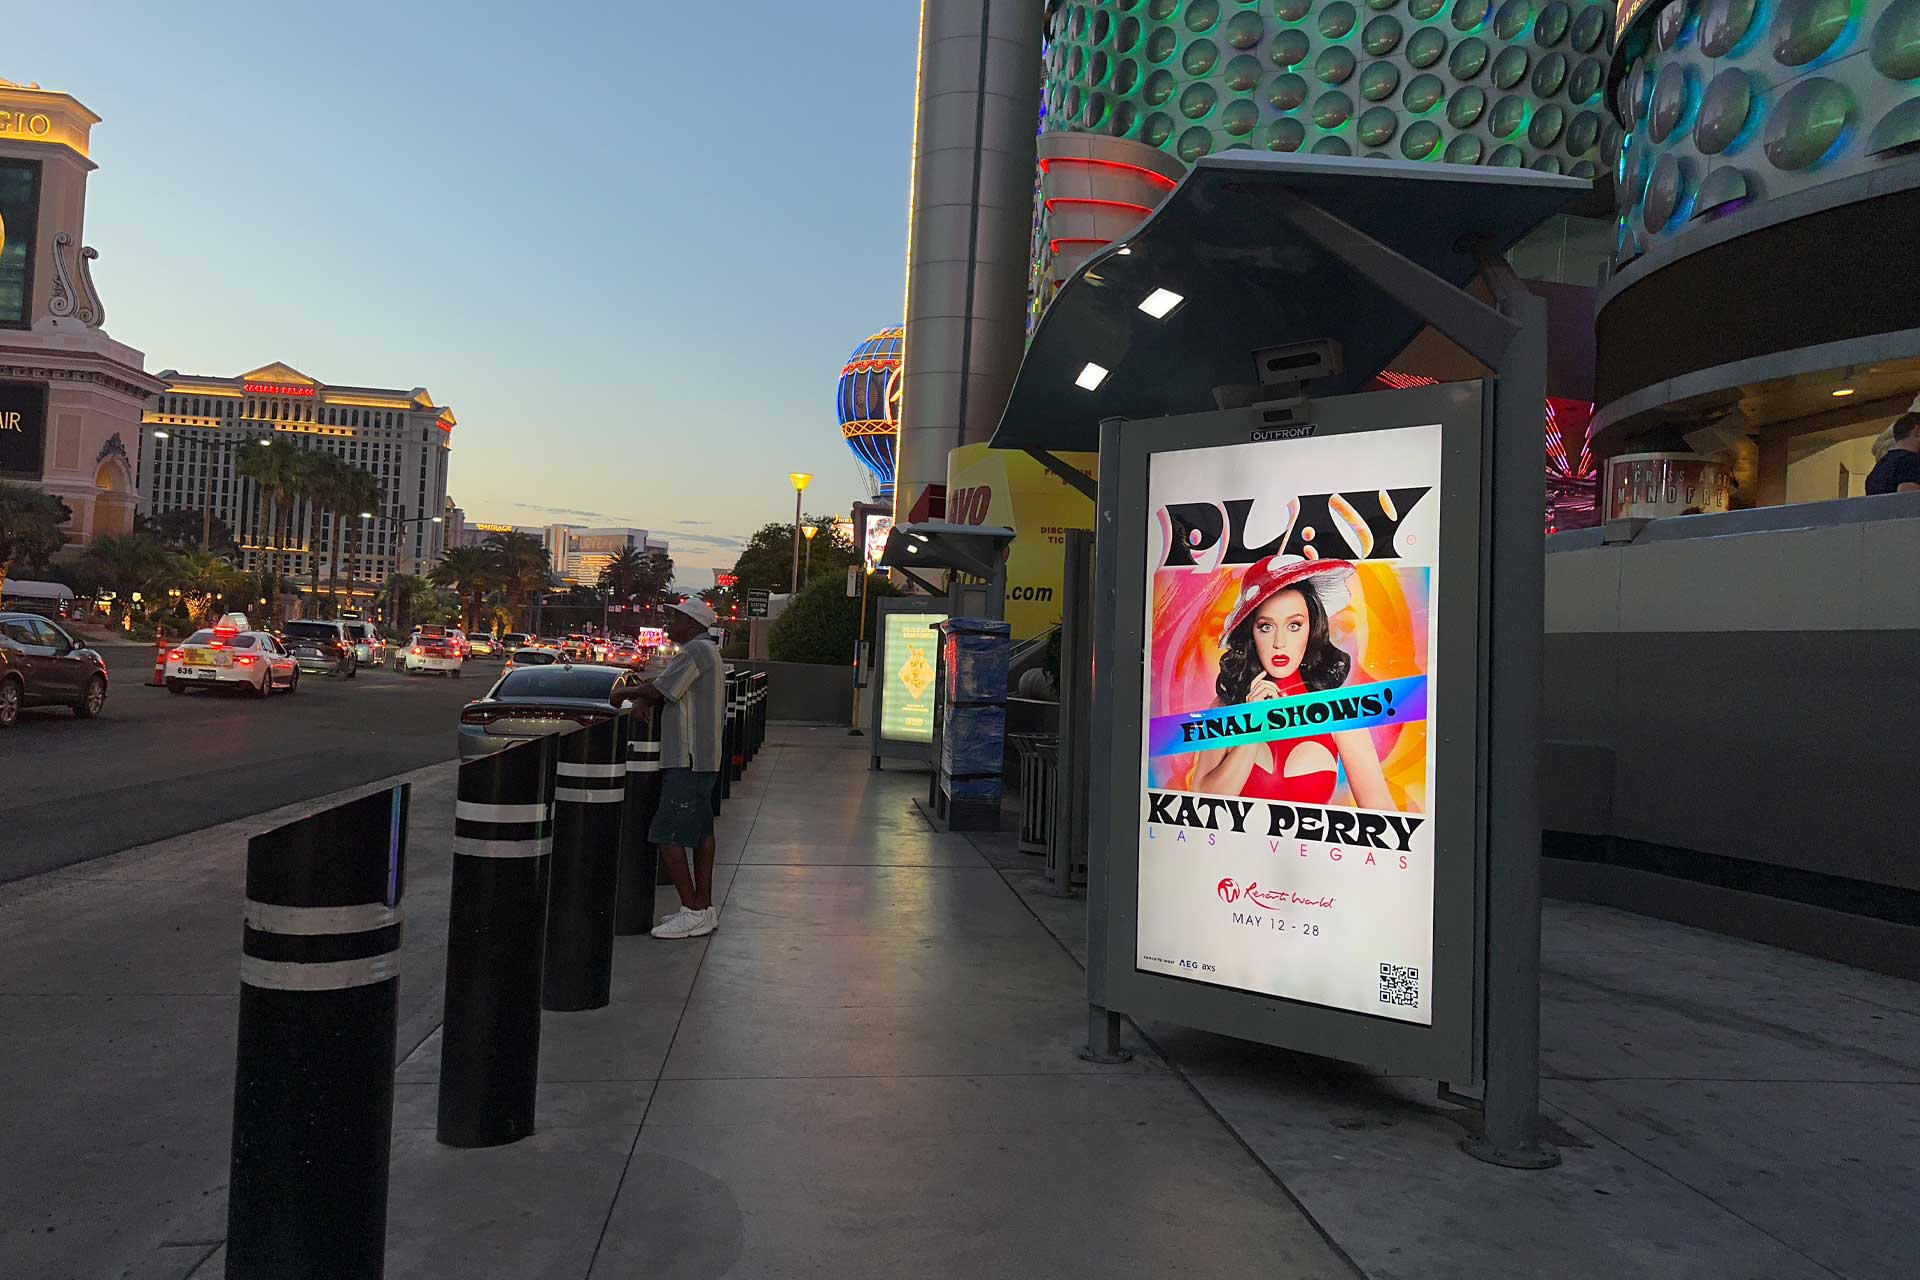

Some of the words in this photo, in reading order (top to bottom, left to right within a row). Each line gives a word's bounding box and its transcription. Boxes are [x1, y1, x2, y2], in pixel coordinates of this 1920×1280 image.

[282, 386, 315, 397] PALACE
[1253, 426, 1313, 440] OUTFRONT
[1634, 470, 1686, 483] CRISS
[1156, 486, 1433, 573] PLAY
[177, 667, 193, 675] 636
[1180, 713, 1263, 743] FINAL
[1266, 687, 1396, 730] SHOWS!
[1147, 793, 1255, 833] KATY
[1267, 804, 1426, 852] PERRY
[1149, 826, 1217, 846] LAS
[1269, 840, 1408, 870] VEGAS
[1292, 892, 1337, 908] World
[1232, 912, 1262, 927] MAY
[1270, 918, 1285, 931] 12
[1303, 923, 1320, 937] 28
[1201, 963, 1216, 973] axs
